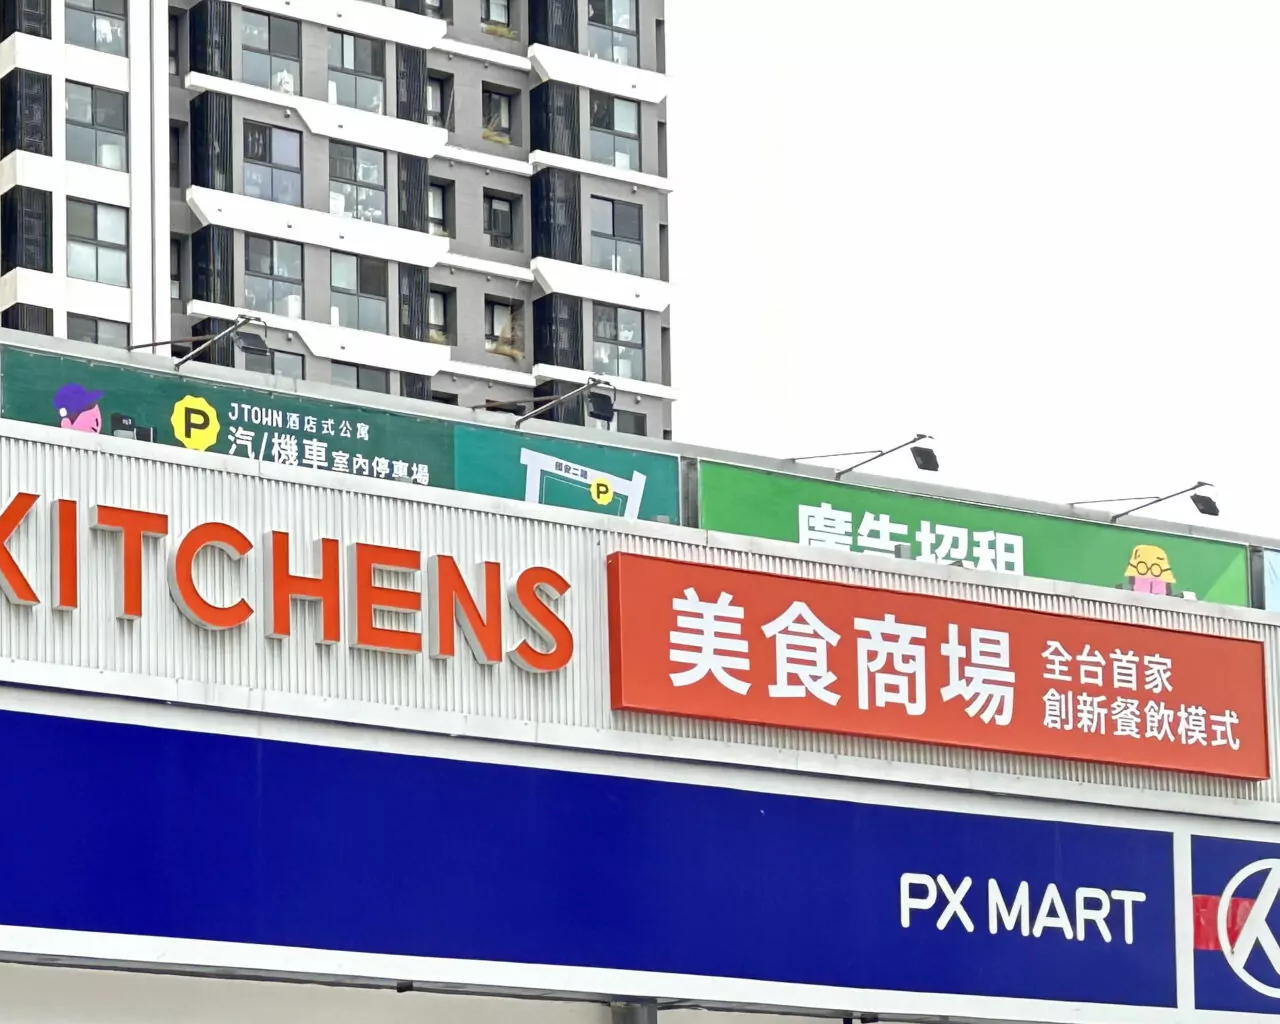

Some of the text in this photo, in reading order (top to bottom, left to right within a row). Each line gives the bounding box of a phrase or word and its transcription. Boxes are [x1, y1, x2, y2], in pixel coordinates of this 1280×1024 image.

[286, 412, 370, 441] 酒店式公寓
[668, 587, 1017, 727] 美食商場
[1041, 640, 1173, 694] 全台首家
[1042, 687, 1240, 751] 創新餐飲模式
[900, 872, 1147, 945] PX MART
